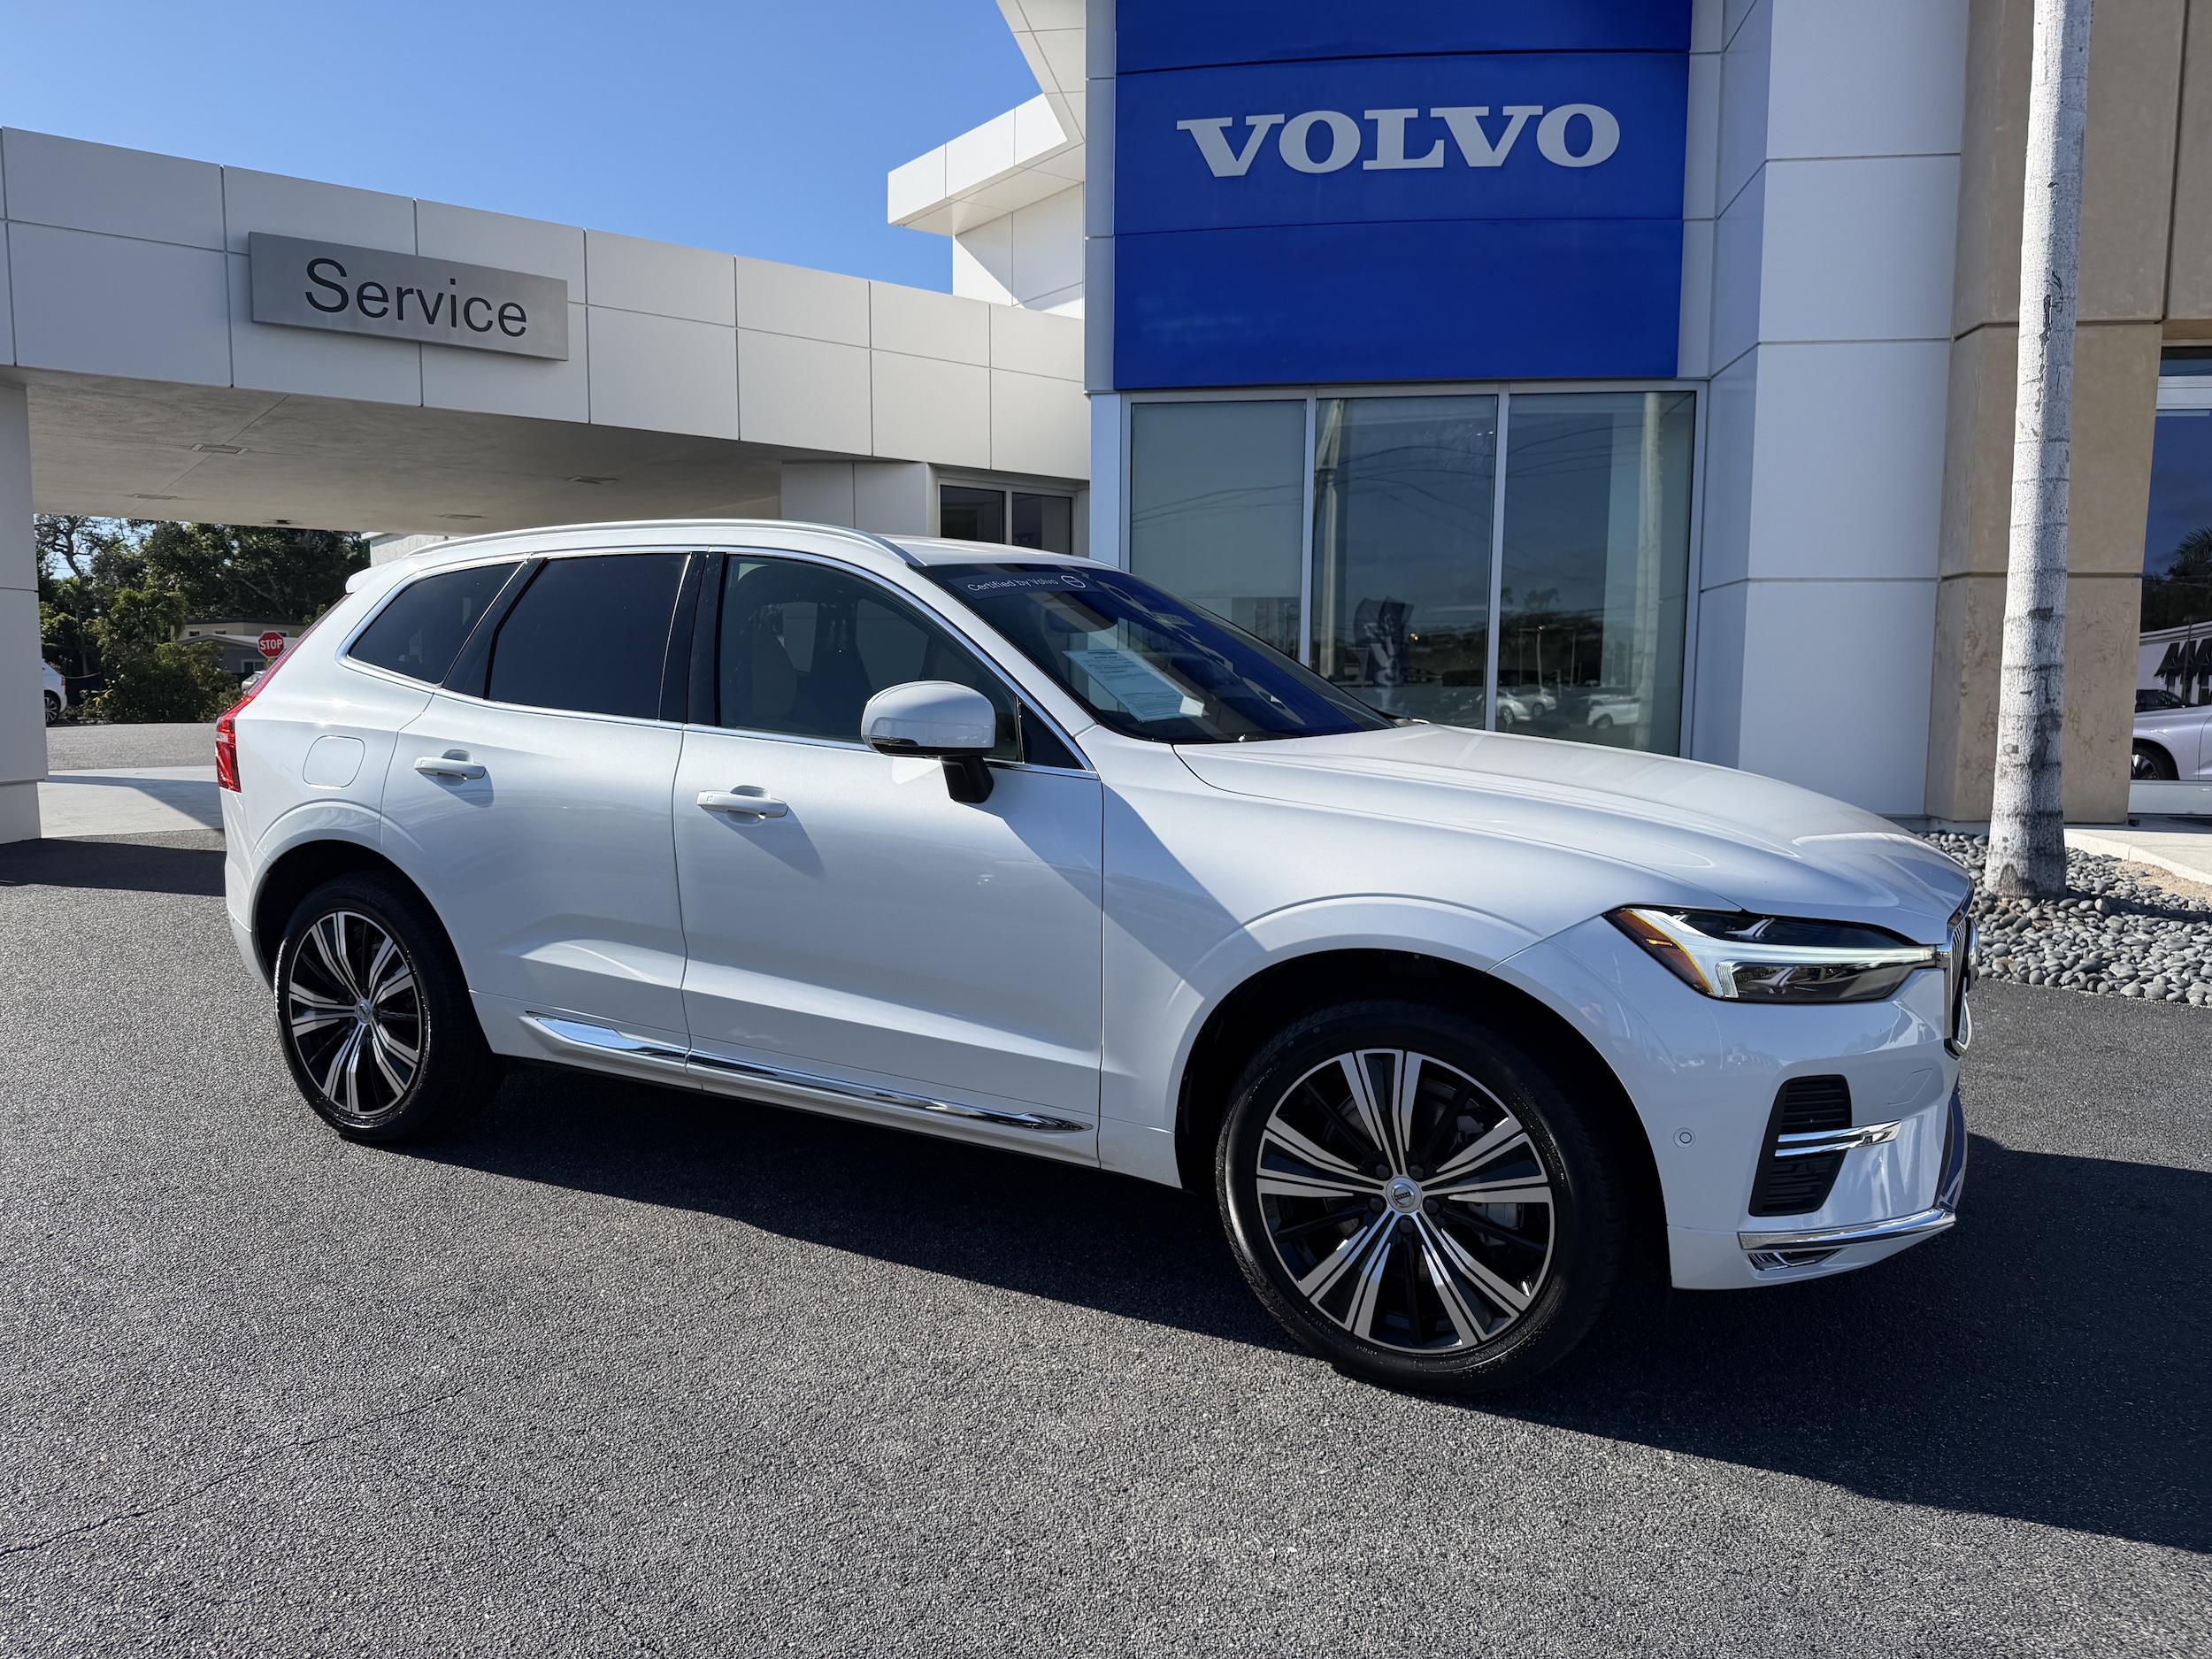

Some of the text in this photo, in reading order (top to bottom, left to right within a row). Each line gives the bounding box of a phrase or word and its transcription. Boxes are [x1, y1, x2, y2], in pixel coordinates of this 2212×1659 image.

[1176, 103, 1621, 178] VOLVO
[304, 257, 527, 337] Service
[967, 580, 1017, 591] Certified
[1013, 579, 1032, 588] by
[259, 639, 283, 650] STOP
